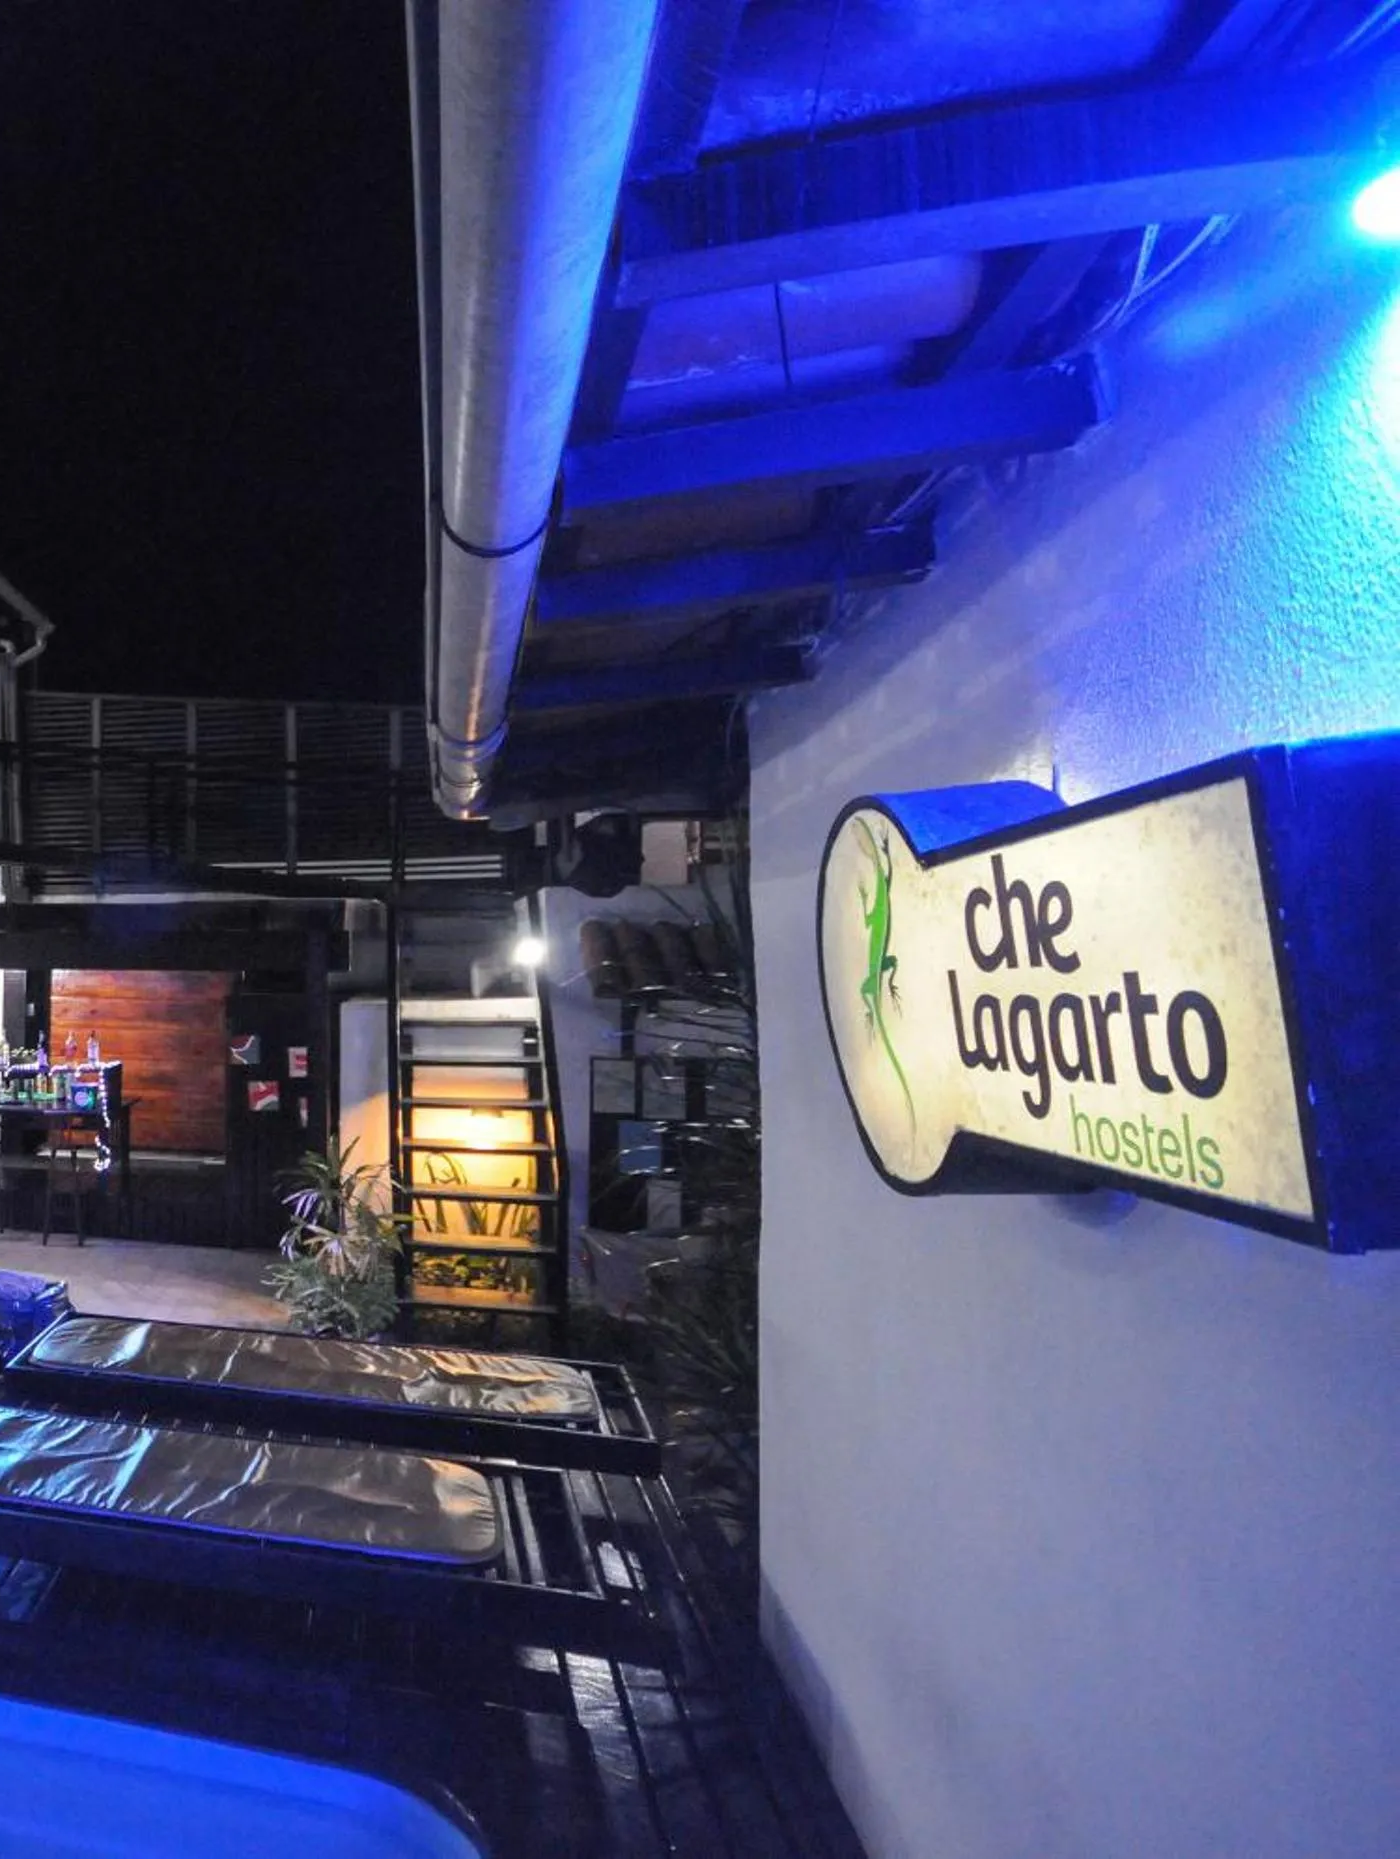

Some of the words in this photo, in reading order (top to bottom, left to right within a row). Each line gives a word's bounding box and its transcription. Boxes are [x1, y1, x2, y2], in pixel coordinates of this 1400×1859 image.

[964, 853, 1081, 973] che
[947, 969, 1228, 1119] lagarto
[1069, 1093, 1224, 1189] hostels
